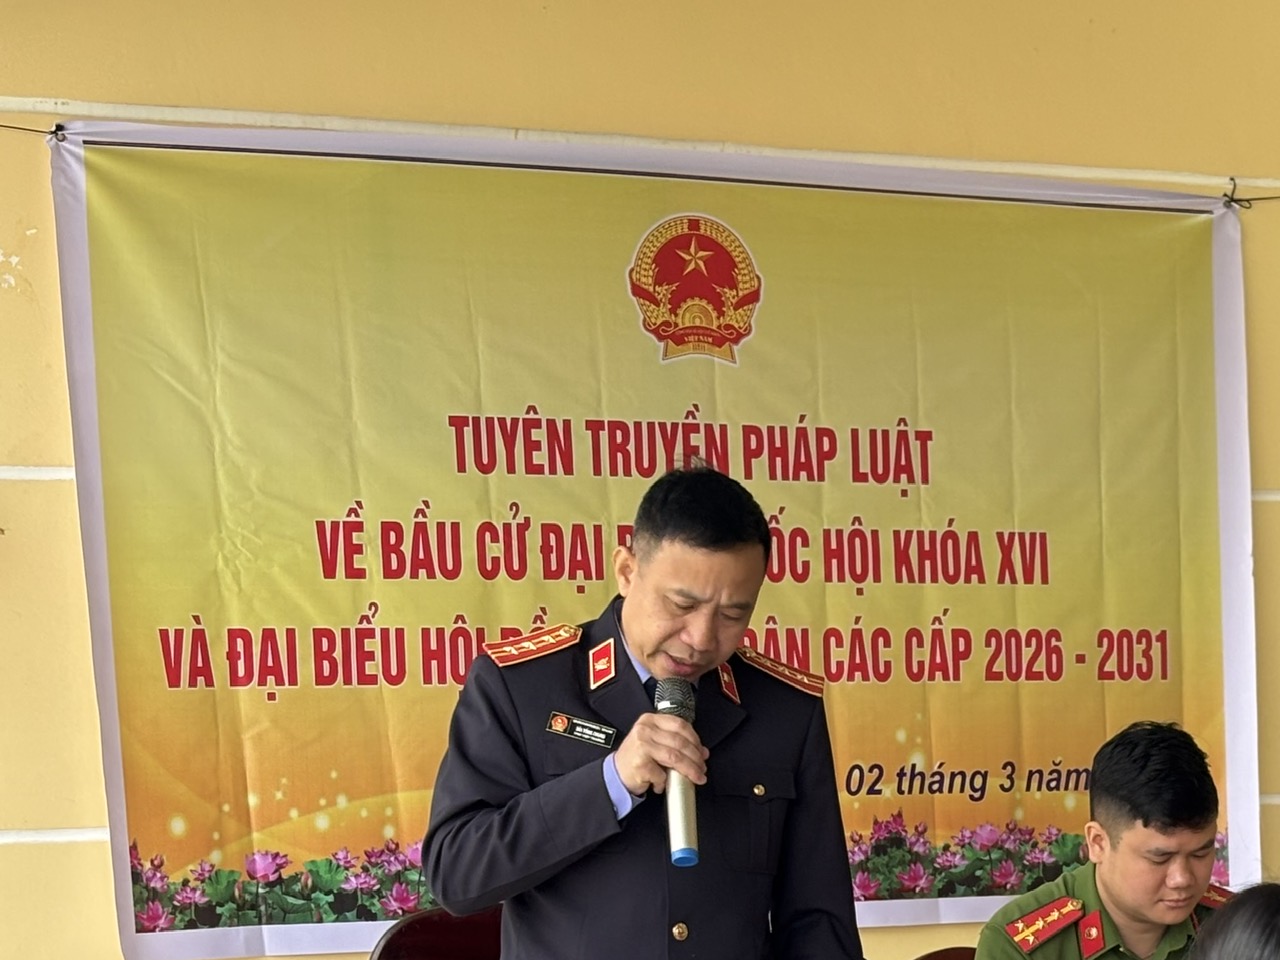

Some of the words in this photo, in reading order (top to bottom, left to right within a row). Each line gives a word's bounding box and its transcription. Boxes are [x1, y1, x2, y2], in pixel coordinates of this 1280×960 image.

[448, 404, 574, 476] TUYÊN
[584, 402, 730, 480] TRUYỀN
[742, 416, 838, 481] PHÁP
[850, 417, 933, 496] LUẬT
[315, 500, 367, 580] VỀ
[380, 501, 462, 581] BẦU
[476, 502, 531, 581] CỬ
[539, 522, 605, 593] ĐẠI
[766, 506, 811, 583] ỐC
[822, 516, 882, 596] HỘI
[892, 517, 986, 585] KHÓA
[996, 531, 1049, 585] XVI
[158, 616, 215, 689] VÀ
[225, 627, 299, 702] ĐẠI
[312, 602, 407, 687] BIỂU
[823, 615, 892, 684] CÁC
[904, 607, 973, 683] CẤP
[984, 628, 1064, 682] 2026
[1075, 653, 1086, 664] -
[1097, 628, 1168, 682] 2031
[846, 763, 884, 796] 02
[896, 762, 989, 802] tháng
[999, 760, 1016, 793] 3
[1025, 759, 1092, 792] năm
